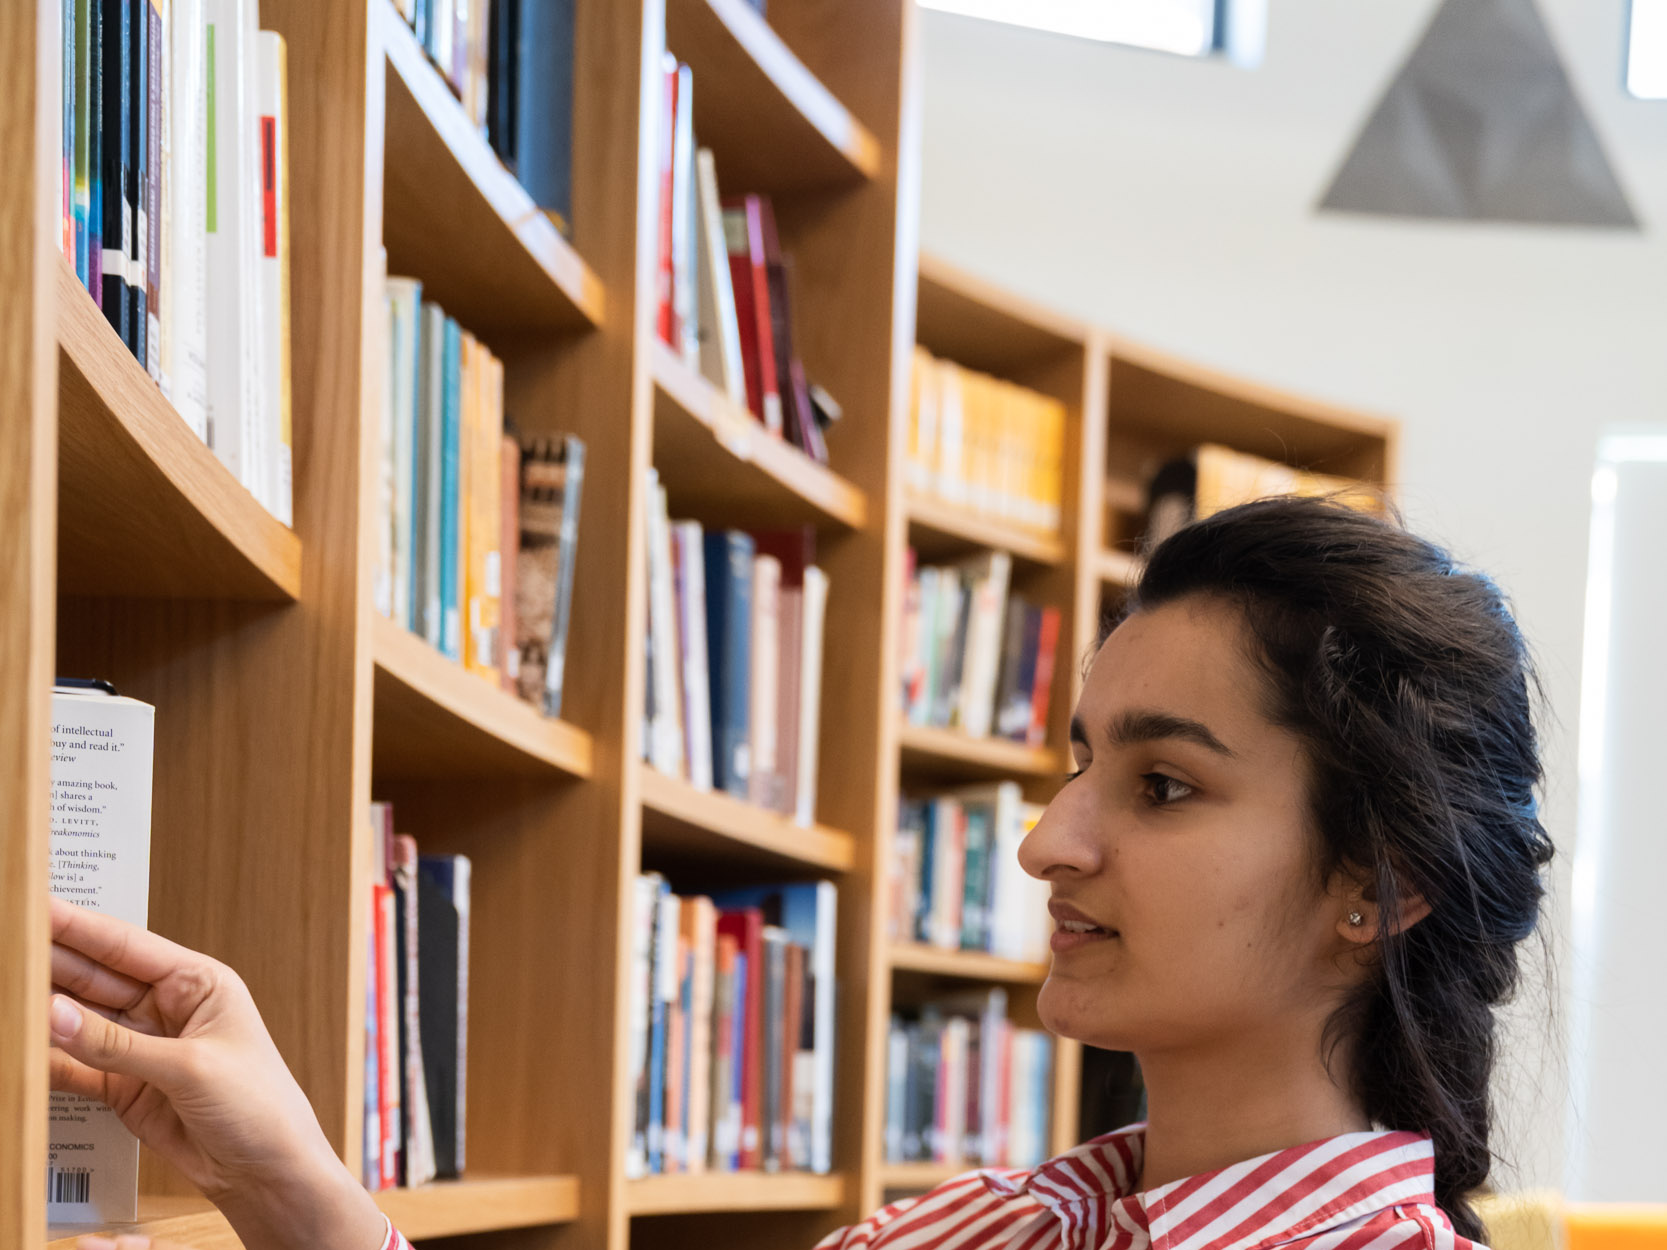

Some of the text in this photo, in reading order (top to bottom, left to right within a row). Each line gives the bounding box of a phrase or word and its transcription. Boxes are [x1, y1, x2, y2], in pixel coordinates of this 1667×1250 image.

[62, 725, 113, 737] intellectual
[69, 740, 87, 750] and
[89, 742, 109, 751] read
[57, 779, 93, 790] amazing
[94, 780, 118, 791] book,
[60, 790, 86, 800] shares
[57, 803, 66, 812] of
[62, 817, 99, 827] LEVITT,
[55, 847, 79, 857] about
[80, 849, 117, 861] thinking
